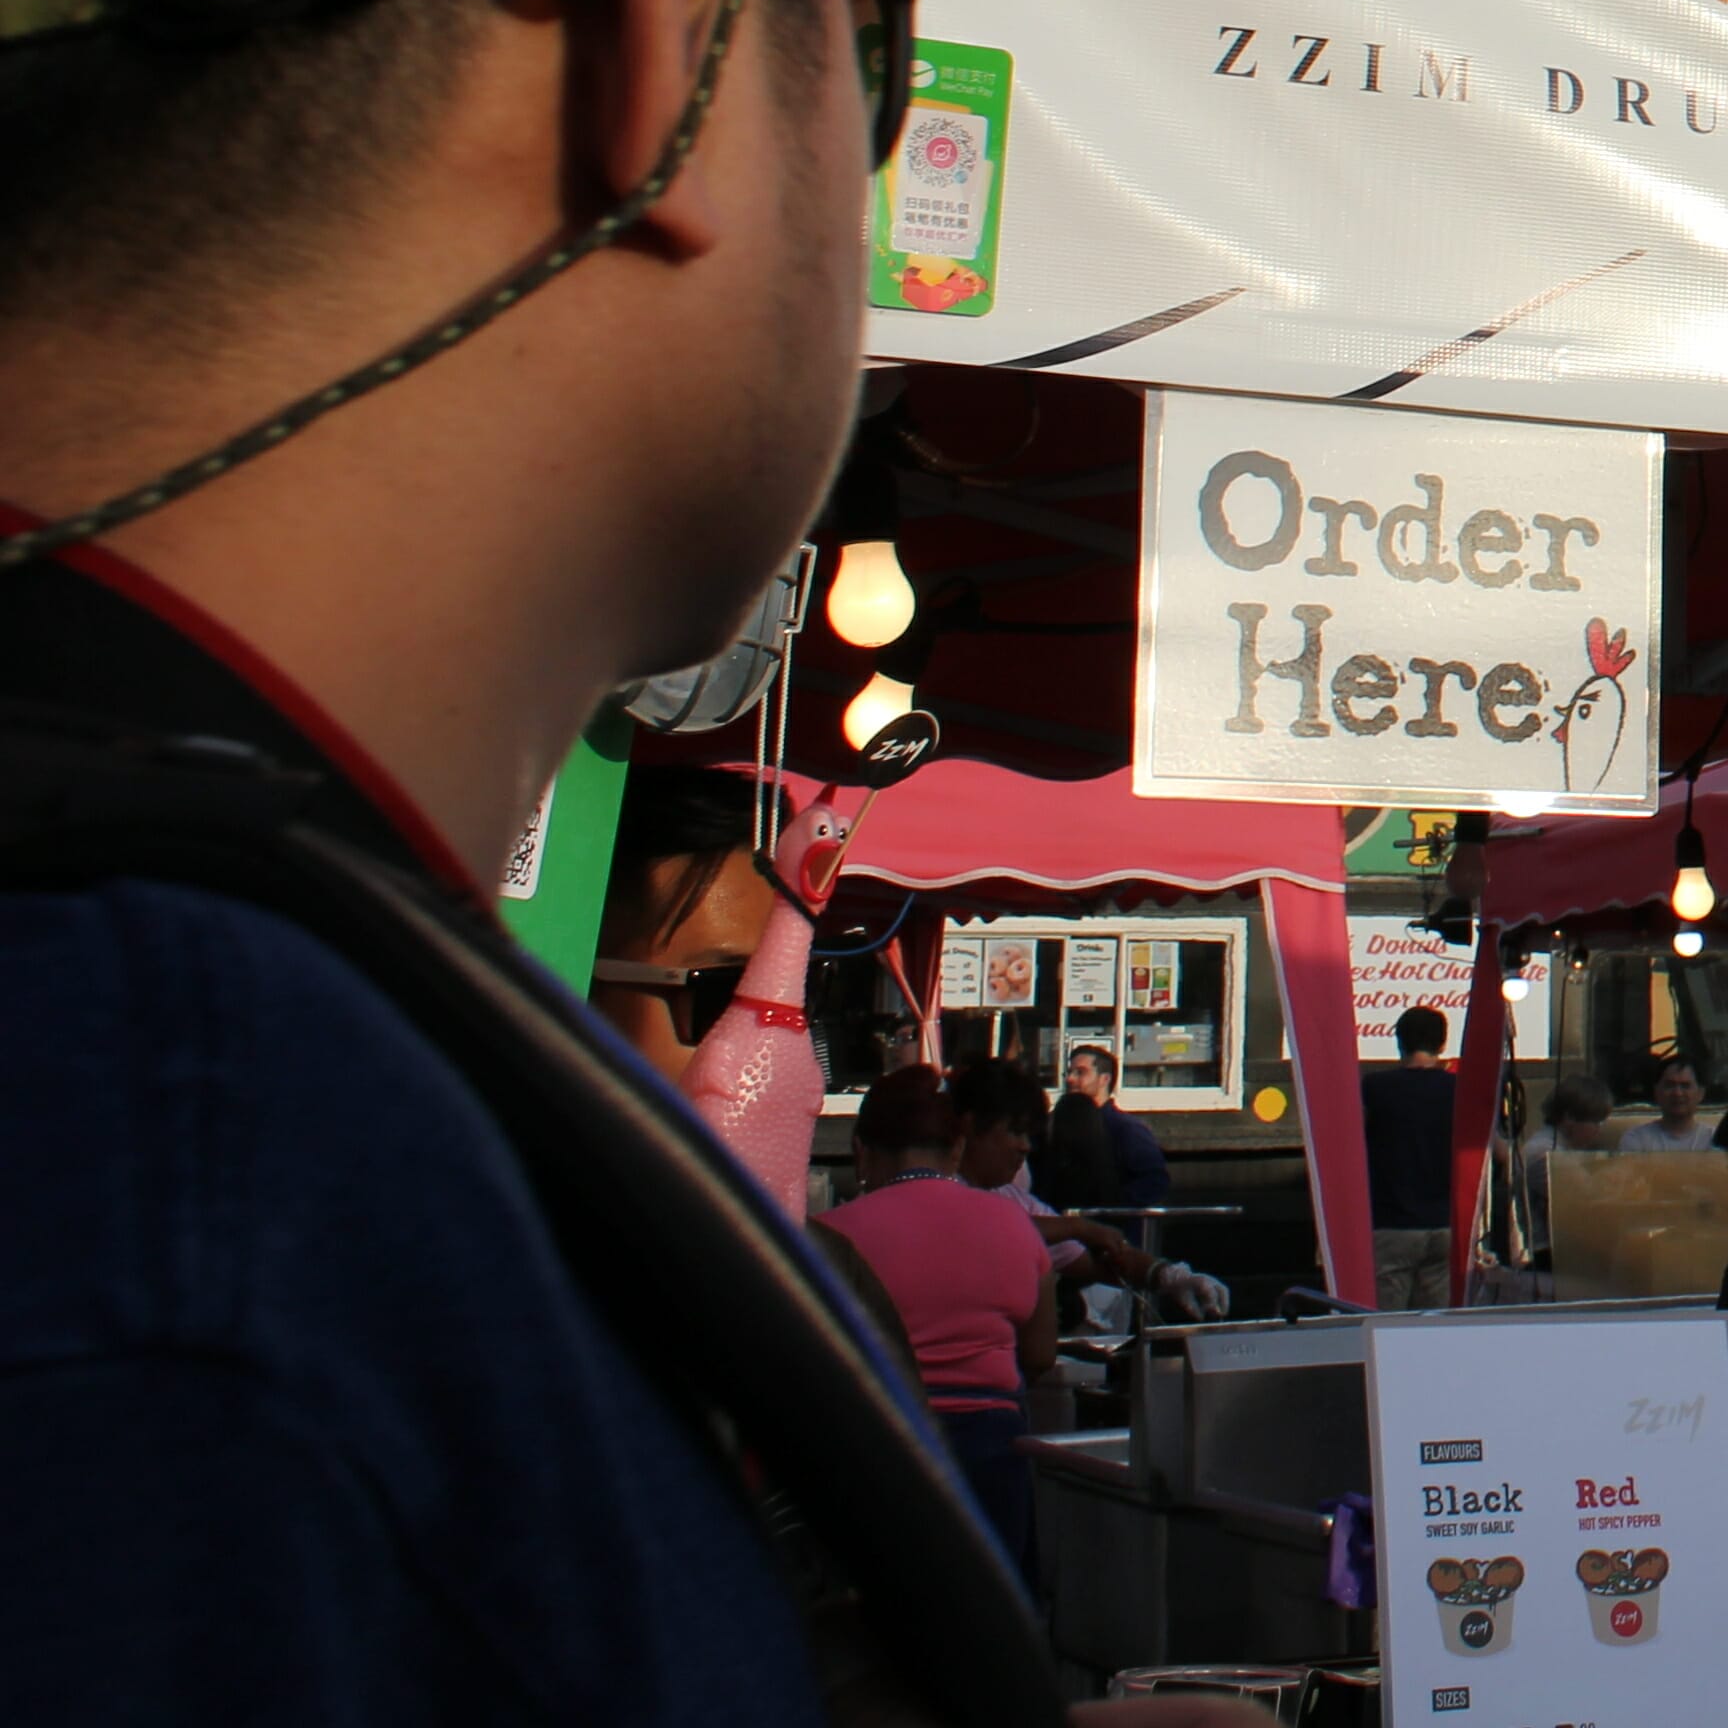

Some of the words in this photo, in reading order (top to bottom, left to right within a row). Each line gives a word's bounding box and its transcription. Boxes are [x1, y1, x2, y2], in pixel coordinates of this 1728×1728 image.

[1214, 25, 1474, 103] ZZIM
[1198, 450, 1600, 592] Order
[1224, 602, 1545, 743] Here
[1379, 960, 1425, 983] Hot
[1383, 993, 1410, 1009] or
[1623, 1392, 1706, 1443] ZZIM
[1423, 1443, 1481, 1461] FLAVOURS
[1422, 1483, 1524, 1517] Black
[1575, 1476, 1641, 1510] Red
[1425, 1523, 1458, 1538] SWEET
[1459, 1522, 1480, 1536] SOY
[1480, 1520, 1516, 1536] GARLIC
[1578, 1517, 1597, 1531] HOT
[1598, 1515, 1625, 1530] SPICY
[1626, 1514, 1662, 1529] PEPPER
[1434, 1690, 1468, 1708] SIZES
